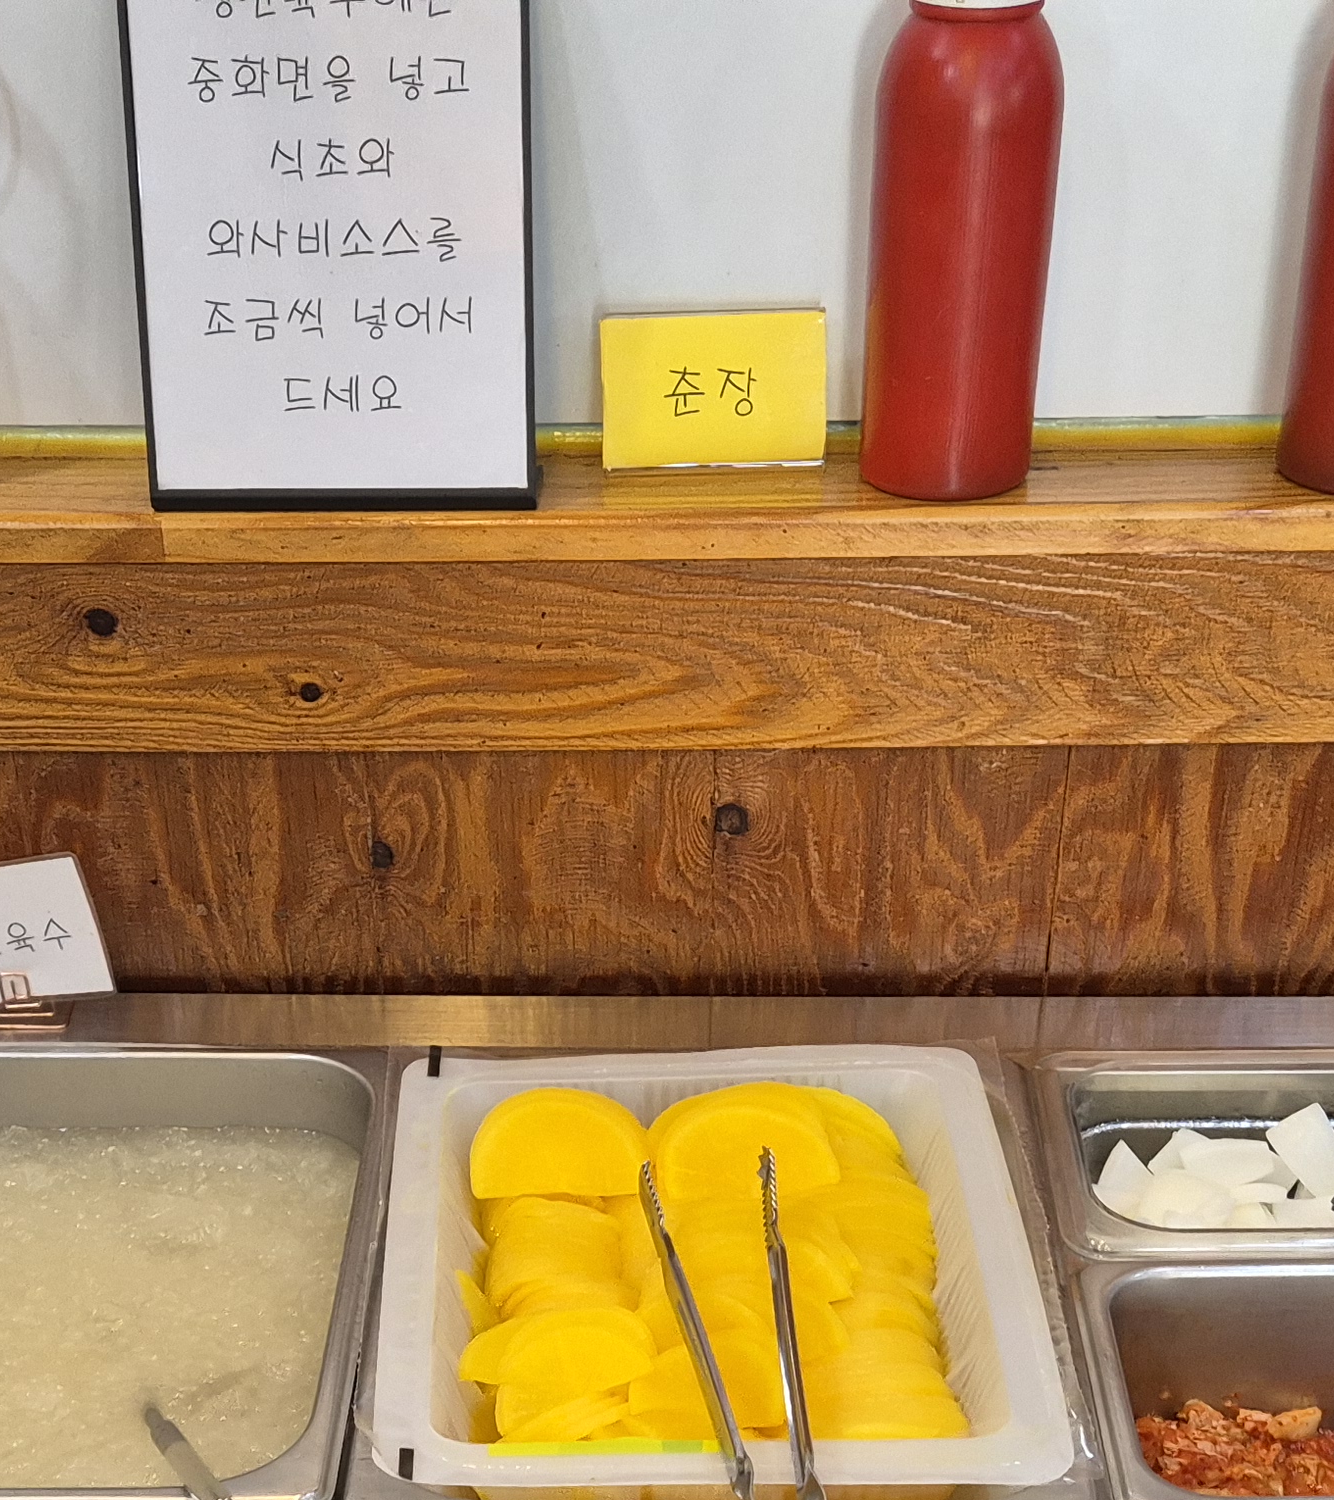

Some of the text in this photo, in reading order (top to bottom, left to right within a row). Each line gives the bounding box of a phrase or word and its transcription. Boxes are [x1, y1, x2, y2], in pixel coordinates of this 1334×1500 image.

[187, 54, 470, 104] 중화면을 넣고
[268, 137, 396, 182] 식초와
[206, 216, 463, 262] 와사비소스를
[202, 297, 475, 343] 조금씩 넣어서
[282, 374, 403, 414] 드세요
[662, 365, 761, 418] 춘장
